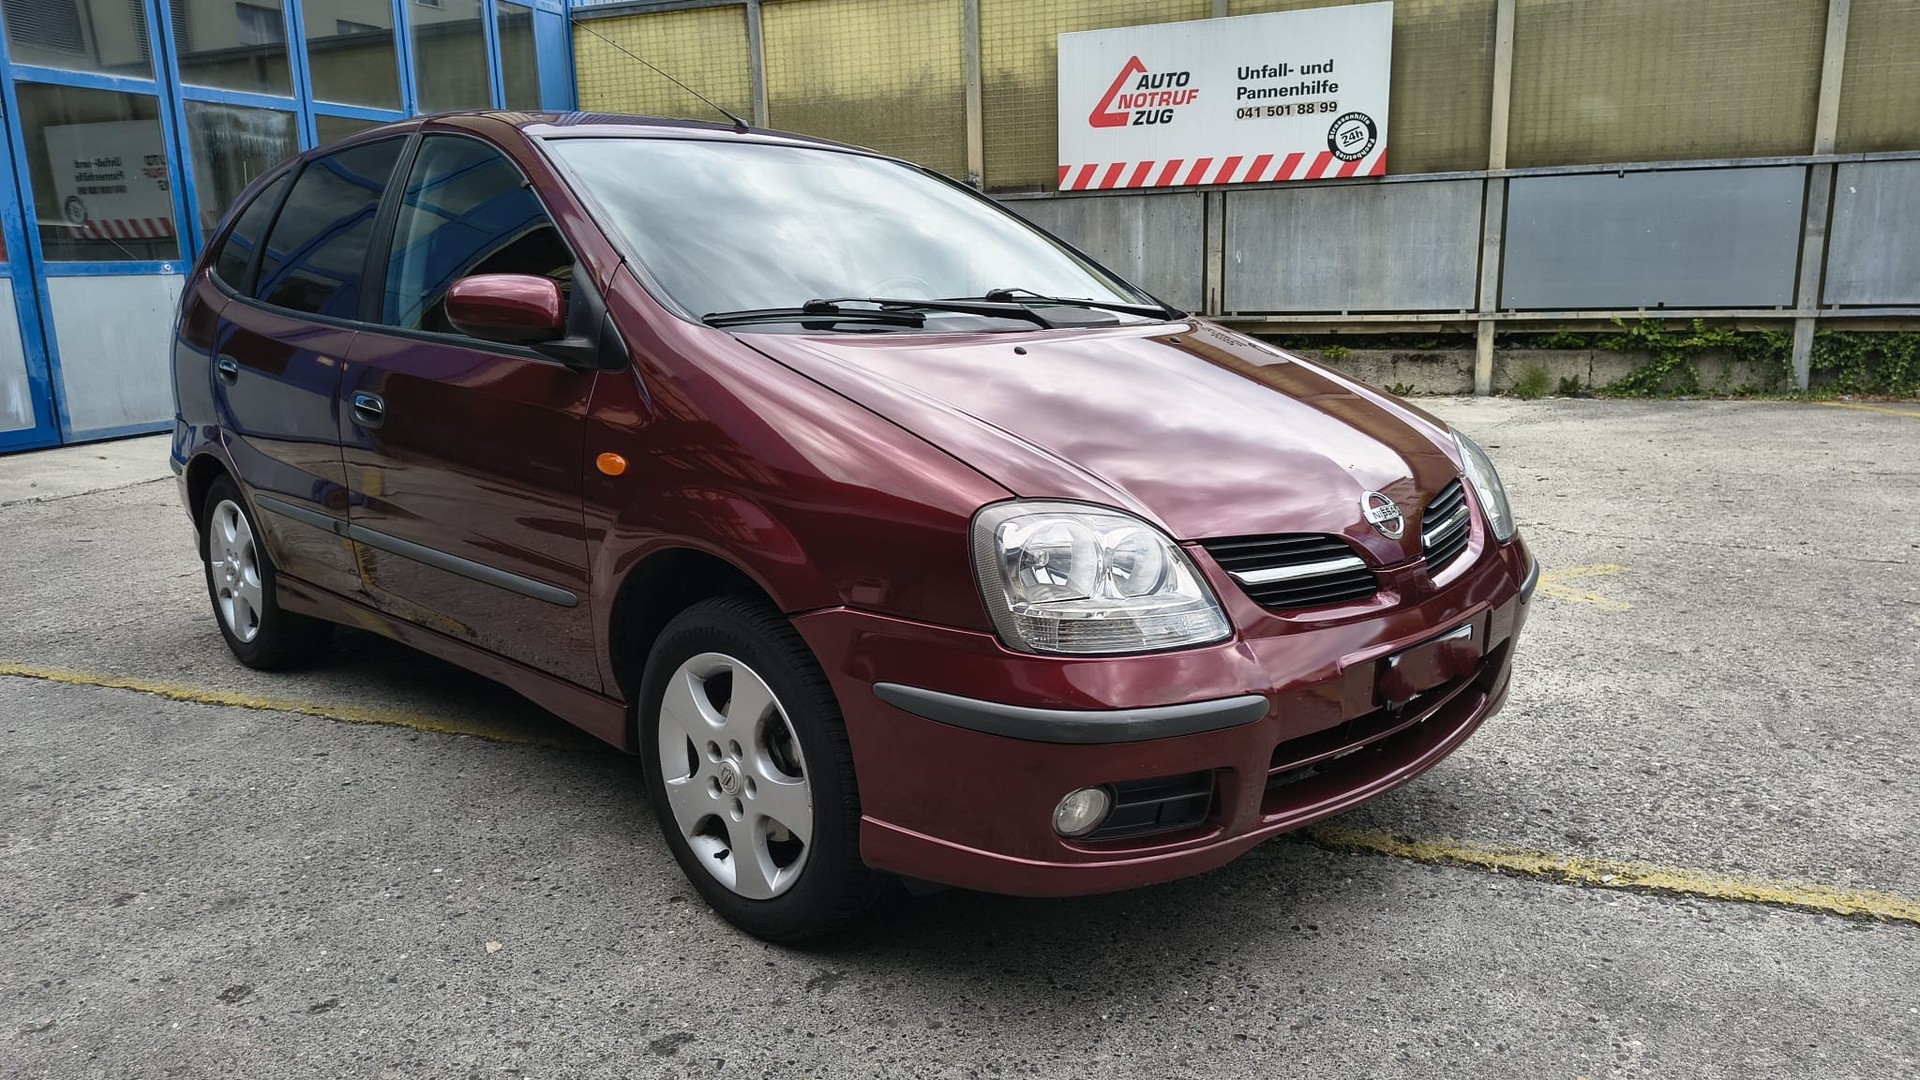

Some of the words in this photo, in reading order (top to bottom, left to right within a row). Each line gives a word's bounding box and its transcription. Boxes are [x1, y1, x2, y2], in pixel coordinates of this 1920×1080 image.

[1237, 63, 1294, 80] Unfall-
[1300, 59, 1334, 75] und
[1136, 71, 1190, 90] AUTO
[1236, 80, 1339, 100] Pannenhilfe
[1118, 89, 1199, 109] NOTRUF
[1132, 109, 1174, 126] ZUG
[1236, 107, 1261, 119] 041
[1267, 105, 1290, 116] 501
[1297, 103, 1315, 114] 88
[1320, 101, 1338, 113] 99
[1328, 113, 1371, 140] Strassenhilfe
[1341, 130, 1364, 144] 24h
[1335, 138, 1375, 161] Fachbetrieb
